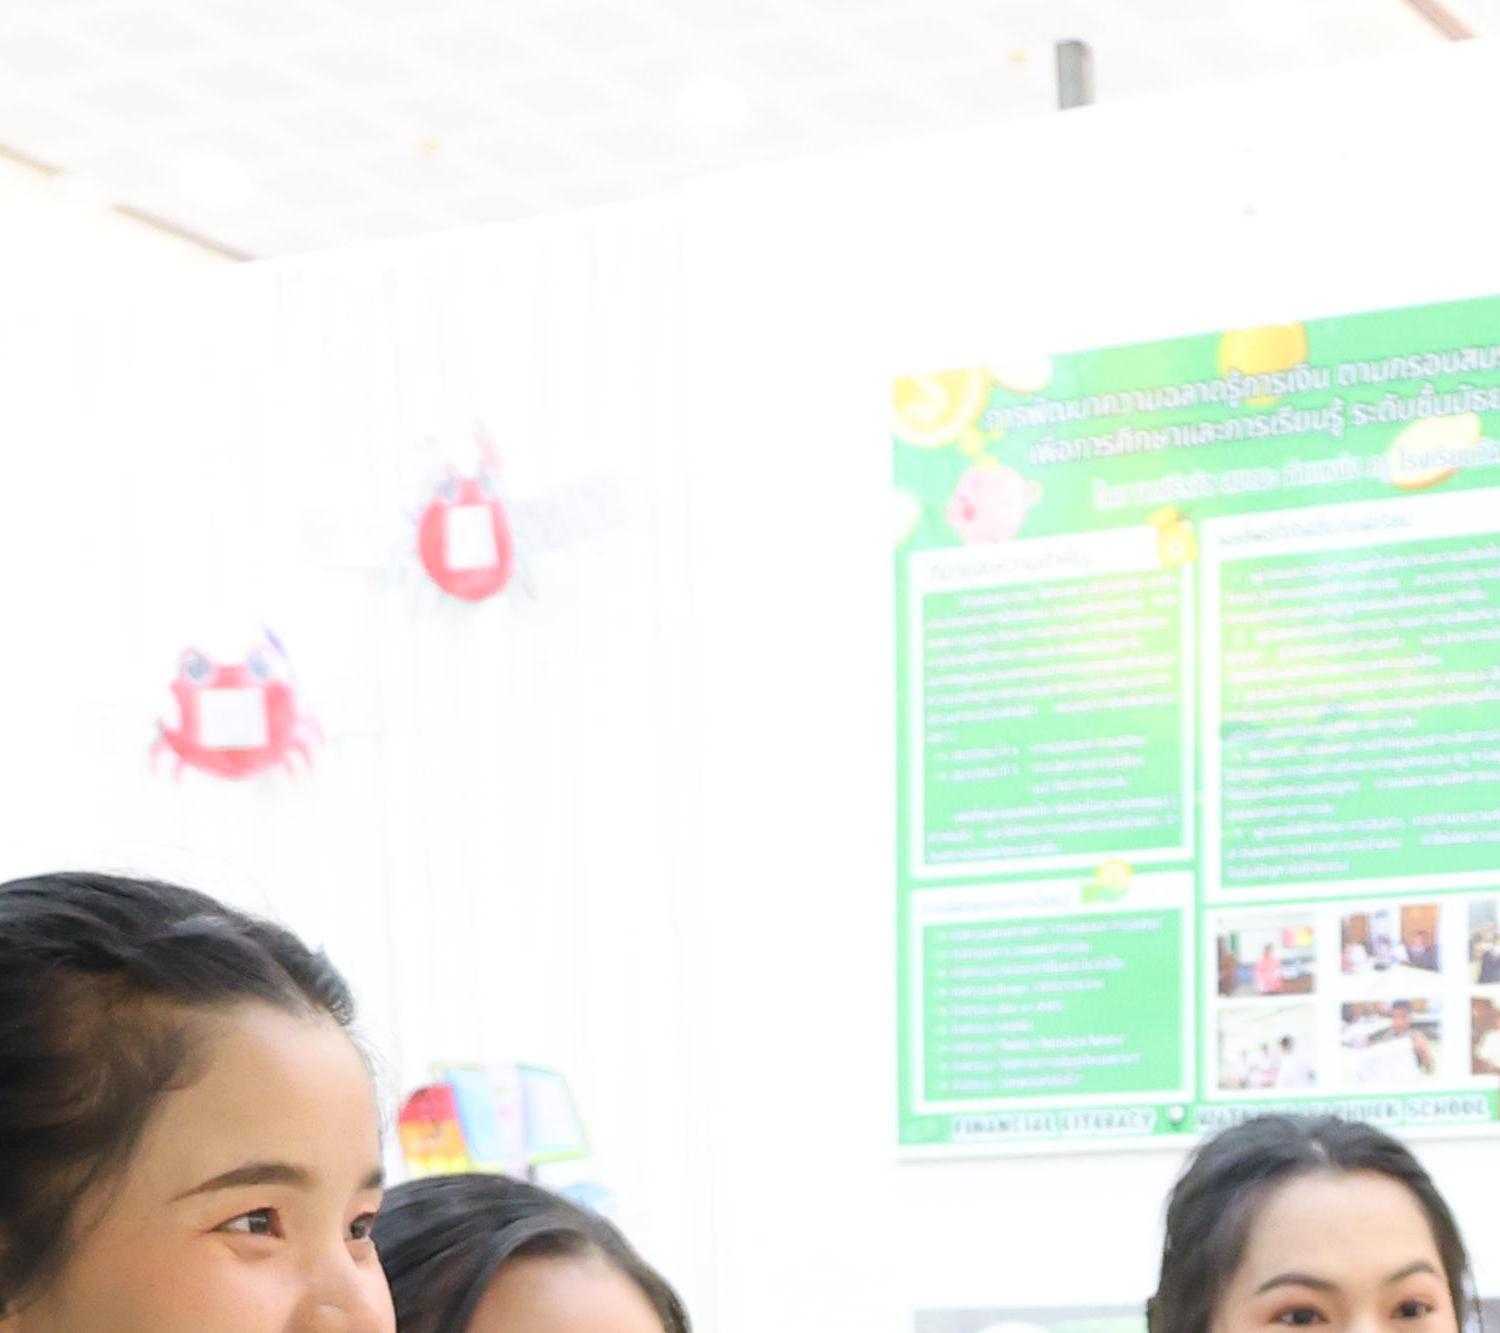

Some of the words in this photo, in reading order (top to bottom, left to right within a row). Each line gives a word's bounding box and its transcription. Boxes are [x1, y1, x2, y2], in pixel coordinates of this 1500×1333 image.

[1407, 1096, 1487, 1121] SCHOOL
[953, 1114, 1054, 1136] FINANCIAL
[1061, 1110, 1153, 1133] LITERACY
